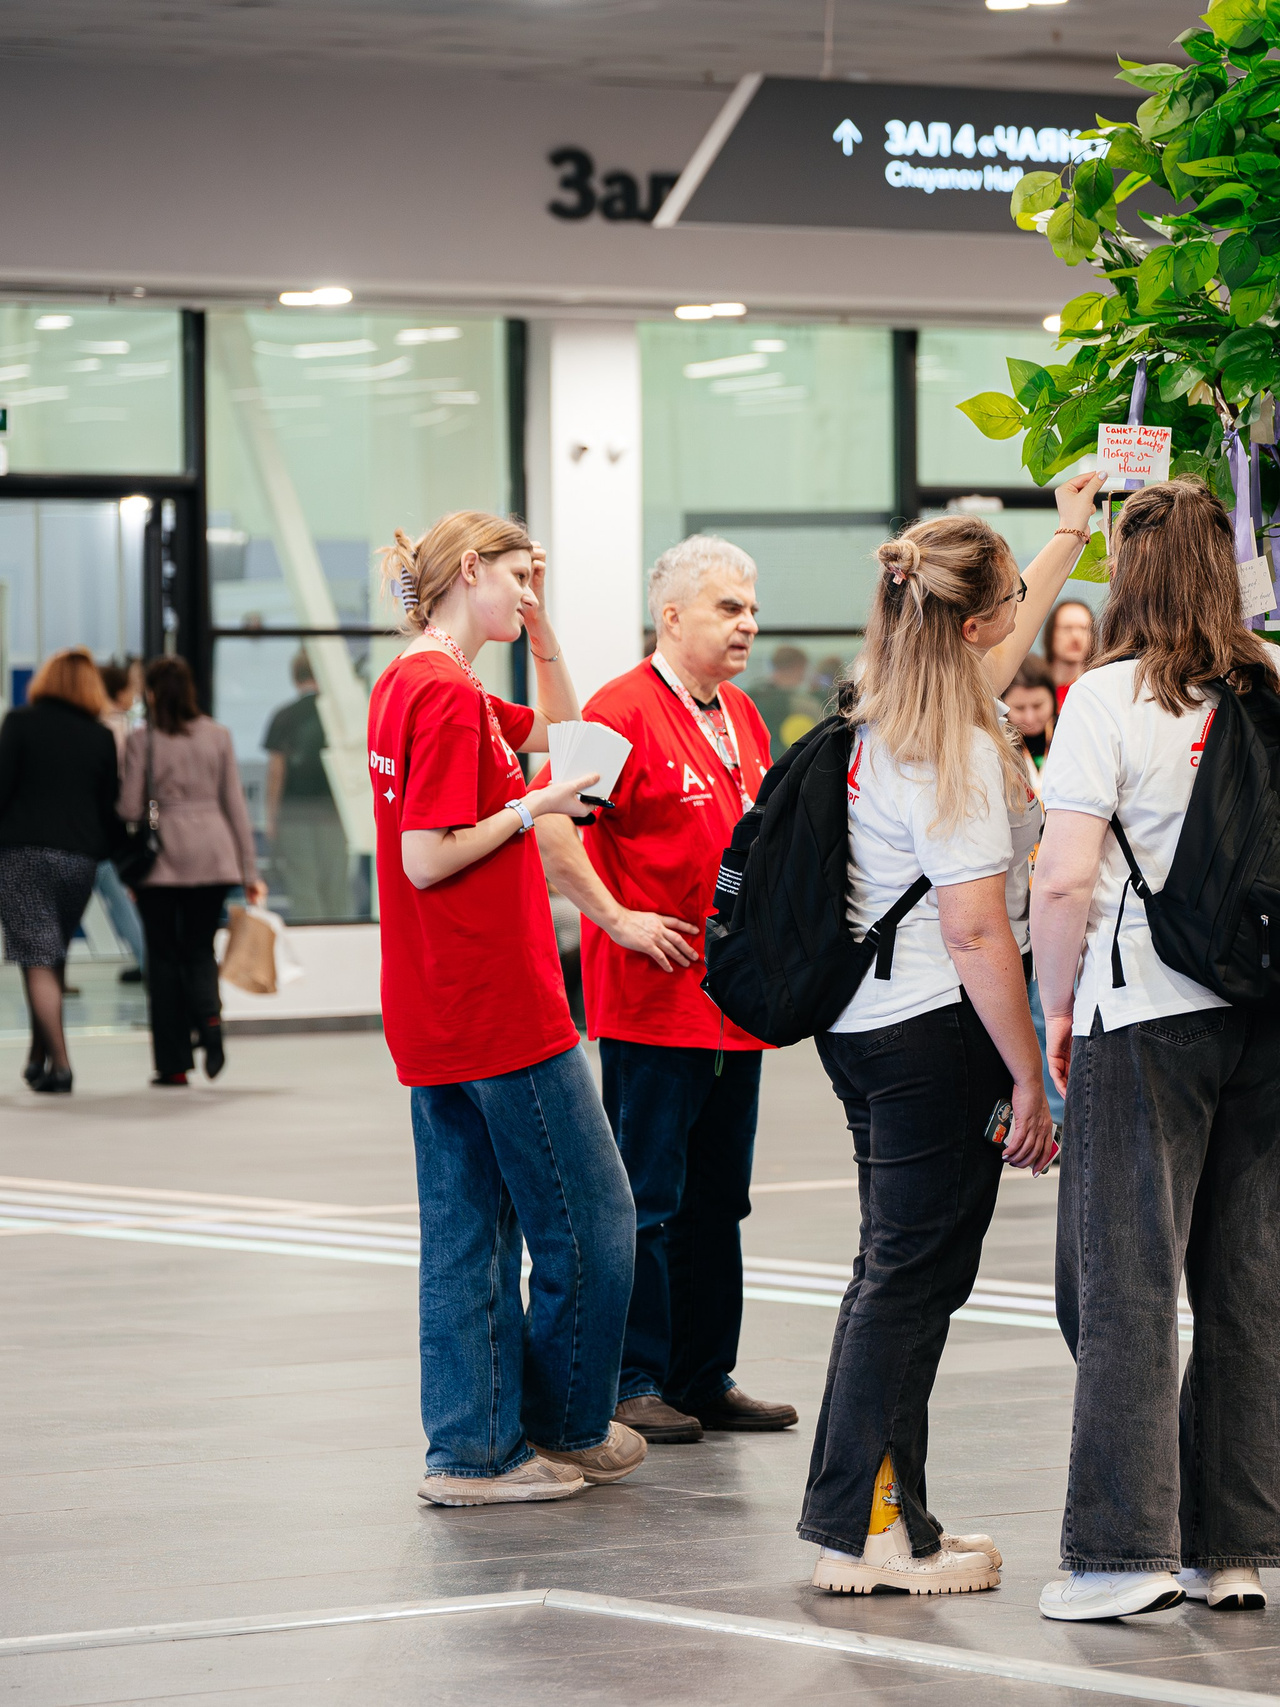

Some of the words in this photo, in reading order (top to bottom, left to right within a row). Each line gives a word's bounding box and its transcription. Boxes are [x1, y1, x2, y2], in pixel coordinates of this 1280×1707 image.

[884, 120, 951, 157] ЗАЛ
[952, 123, 977, 158] 4
[884, 160, 981, 194] Chayanov
